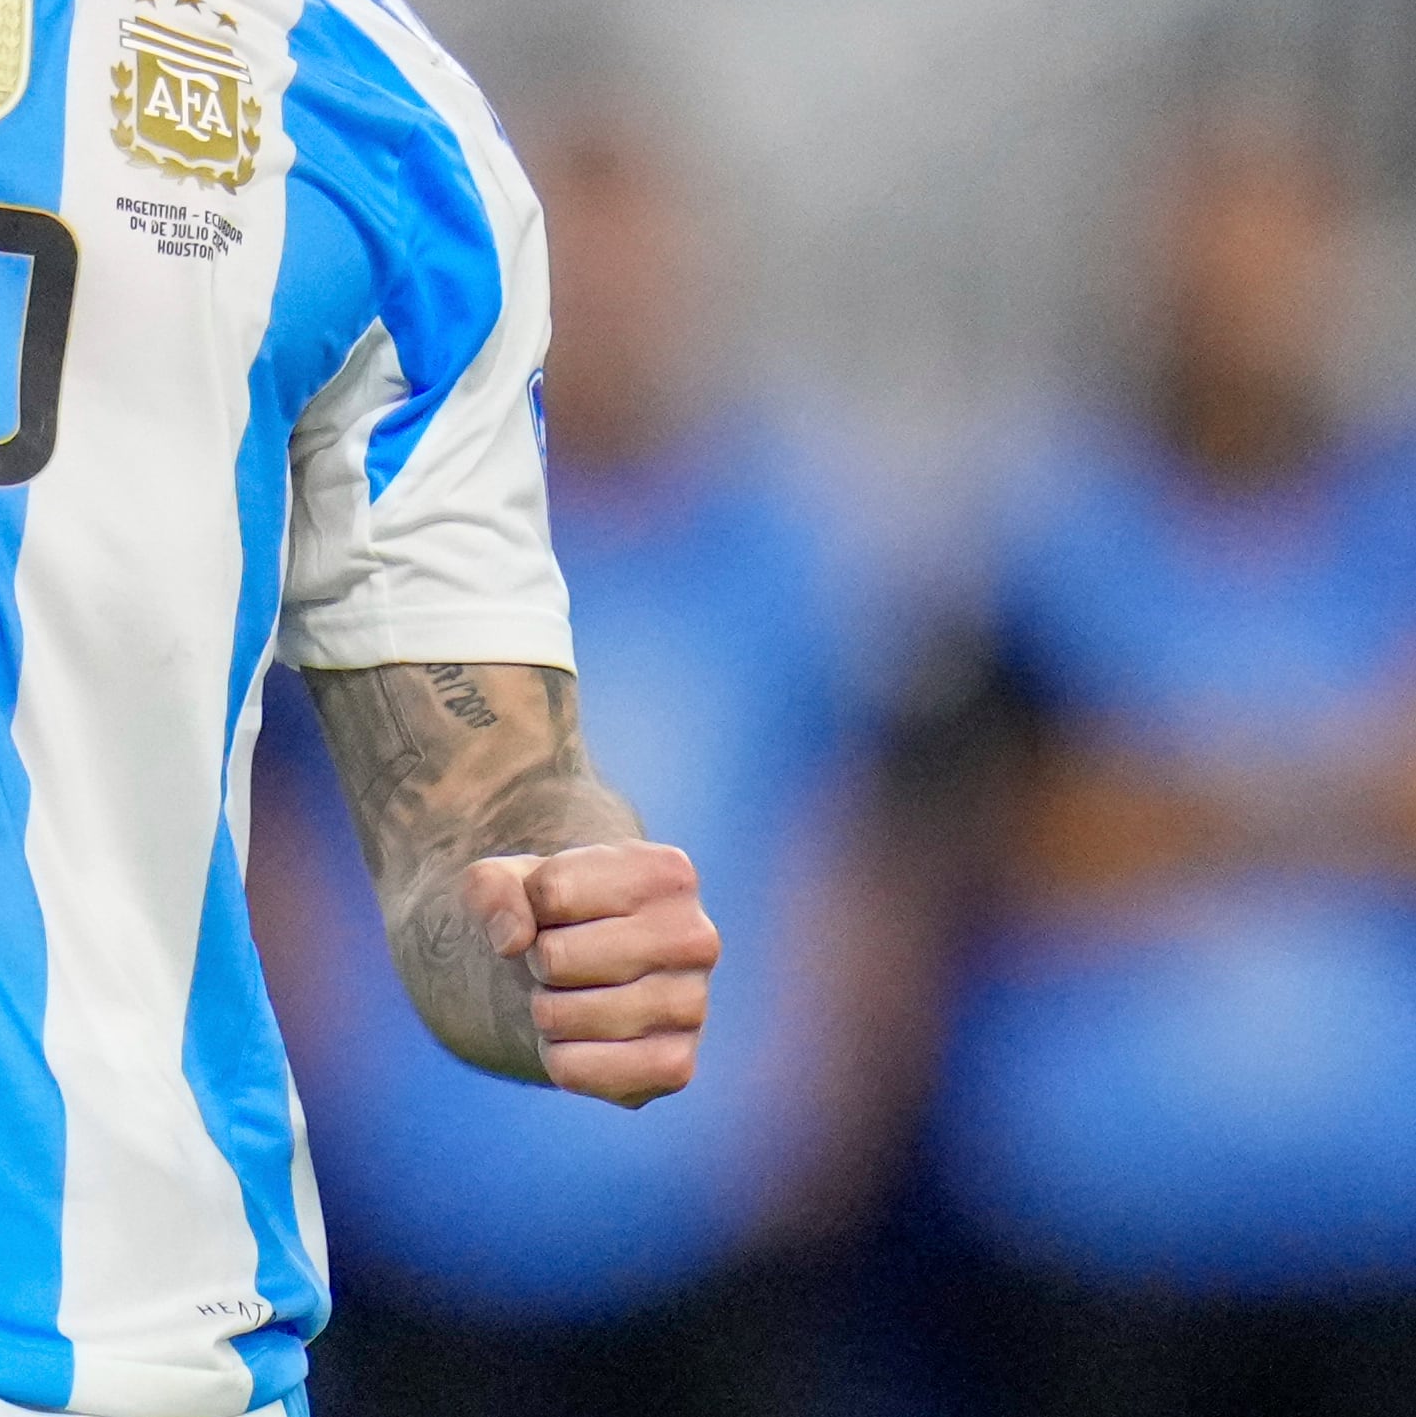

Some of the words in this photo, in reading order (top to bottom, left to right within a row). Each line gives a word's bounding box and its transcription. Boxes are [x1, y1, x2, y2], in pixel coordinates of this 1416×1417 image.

[144, 59, 232, 142] AFA
[116, 197, 187, 221] ARGENTINA
[130, 216, 146, 232] 04
[151, 220, 167, 237] DE
[172, 224, 209, 241] JULIO
[157, 239, 214, 261] HOUSTON
